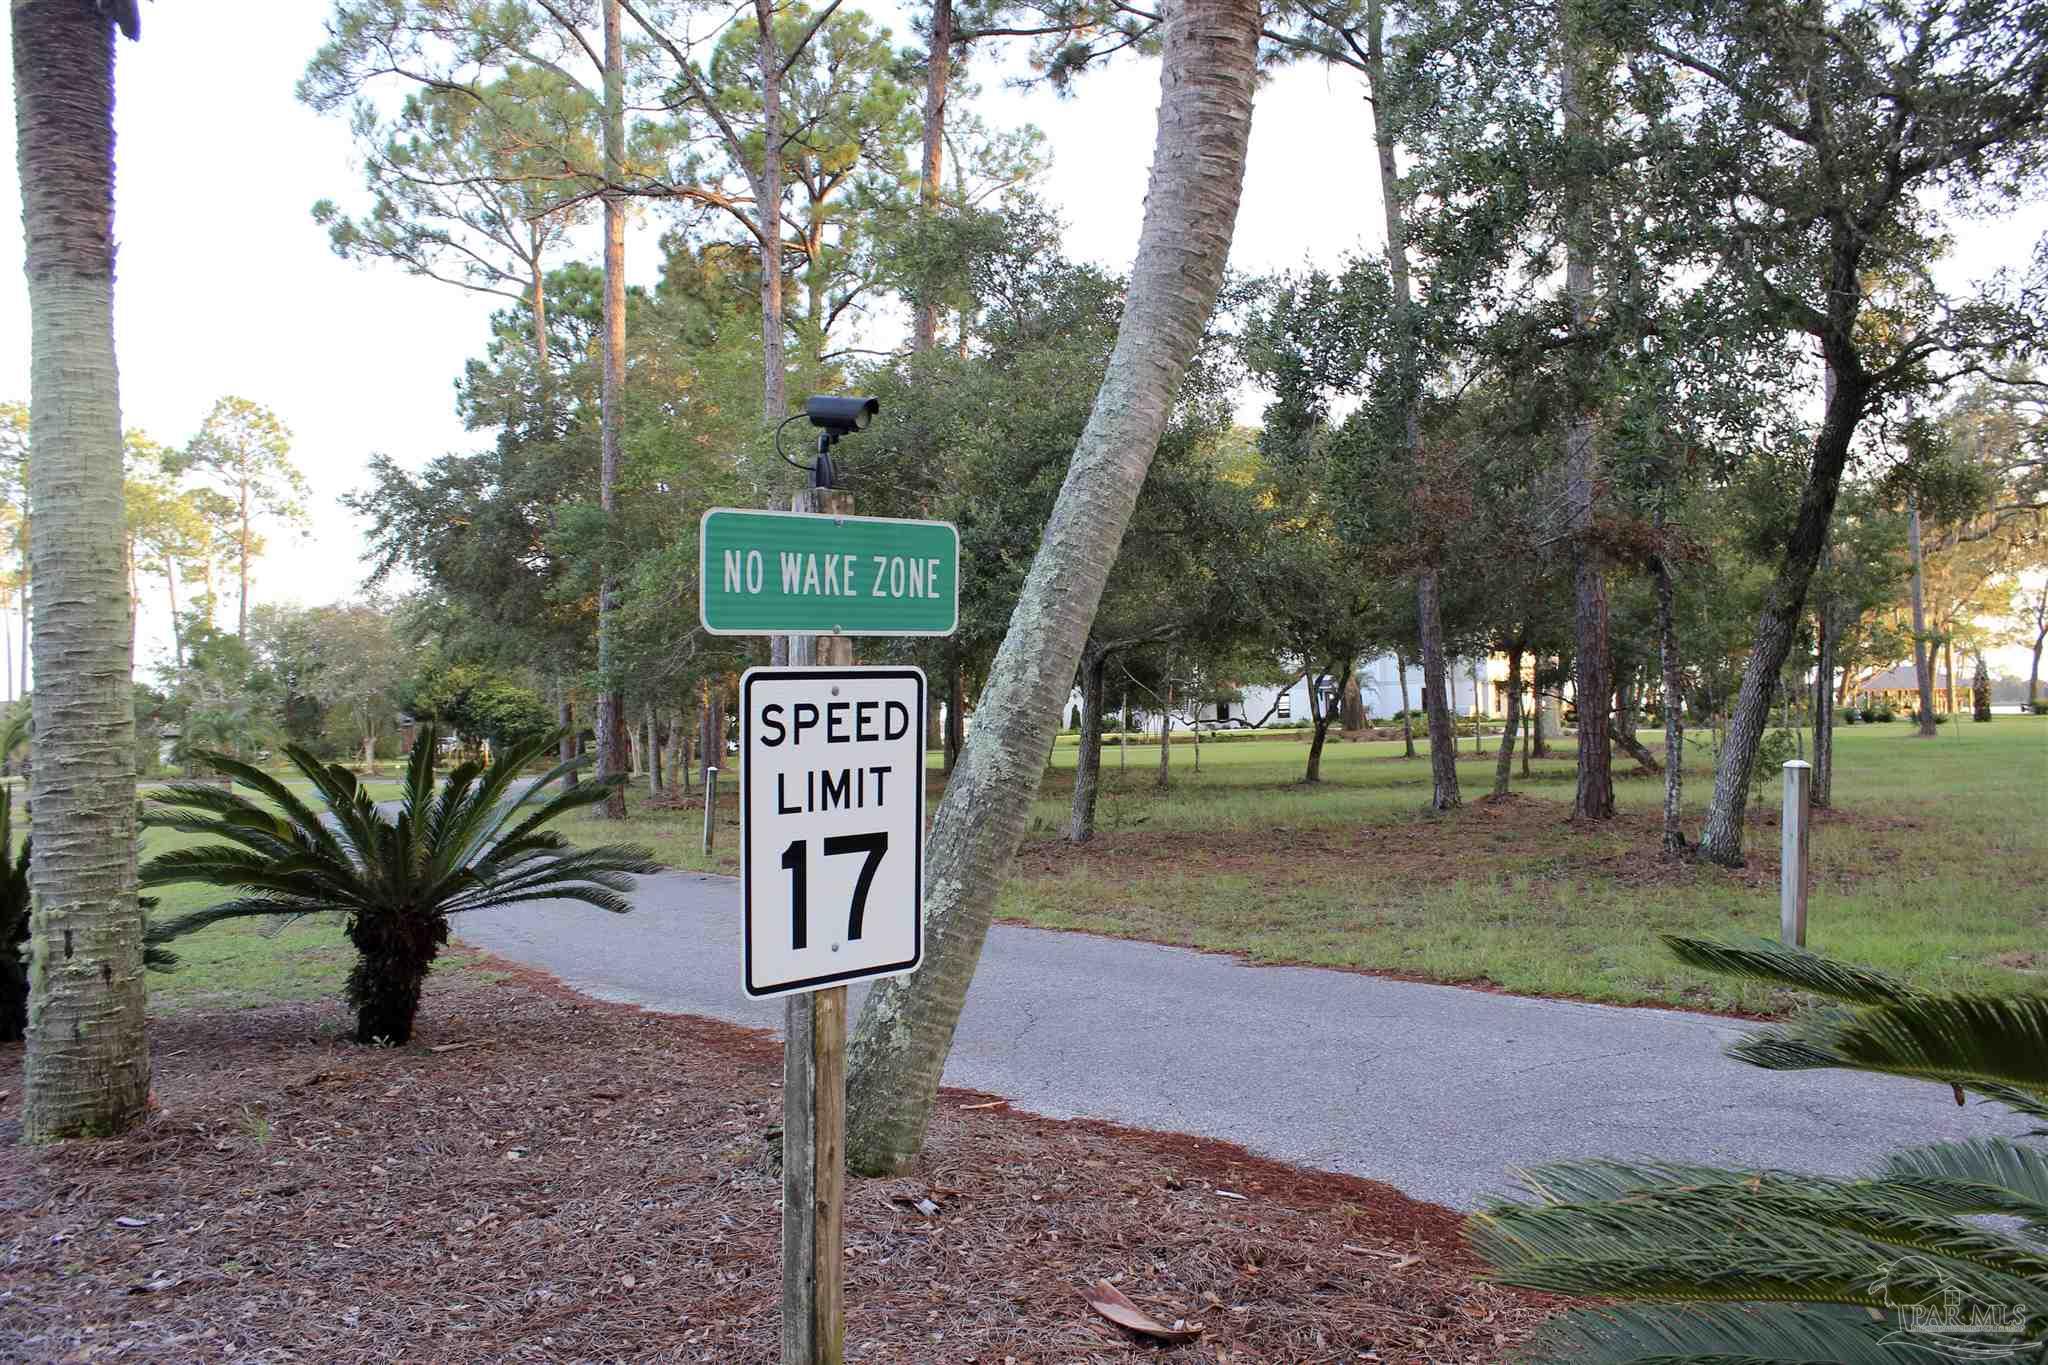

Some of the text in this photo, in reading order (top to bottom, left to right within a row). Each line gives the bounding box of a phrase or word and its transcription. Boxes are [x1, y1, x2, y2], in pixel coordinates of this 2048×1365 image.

[723, 549, 940, 599] NO WAKE ZONE
[760, 701, 909, 747] SPEED
[778, 766, 892, 815] LIMIT
[781, 832, 888, 950] 17
